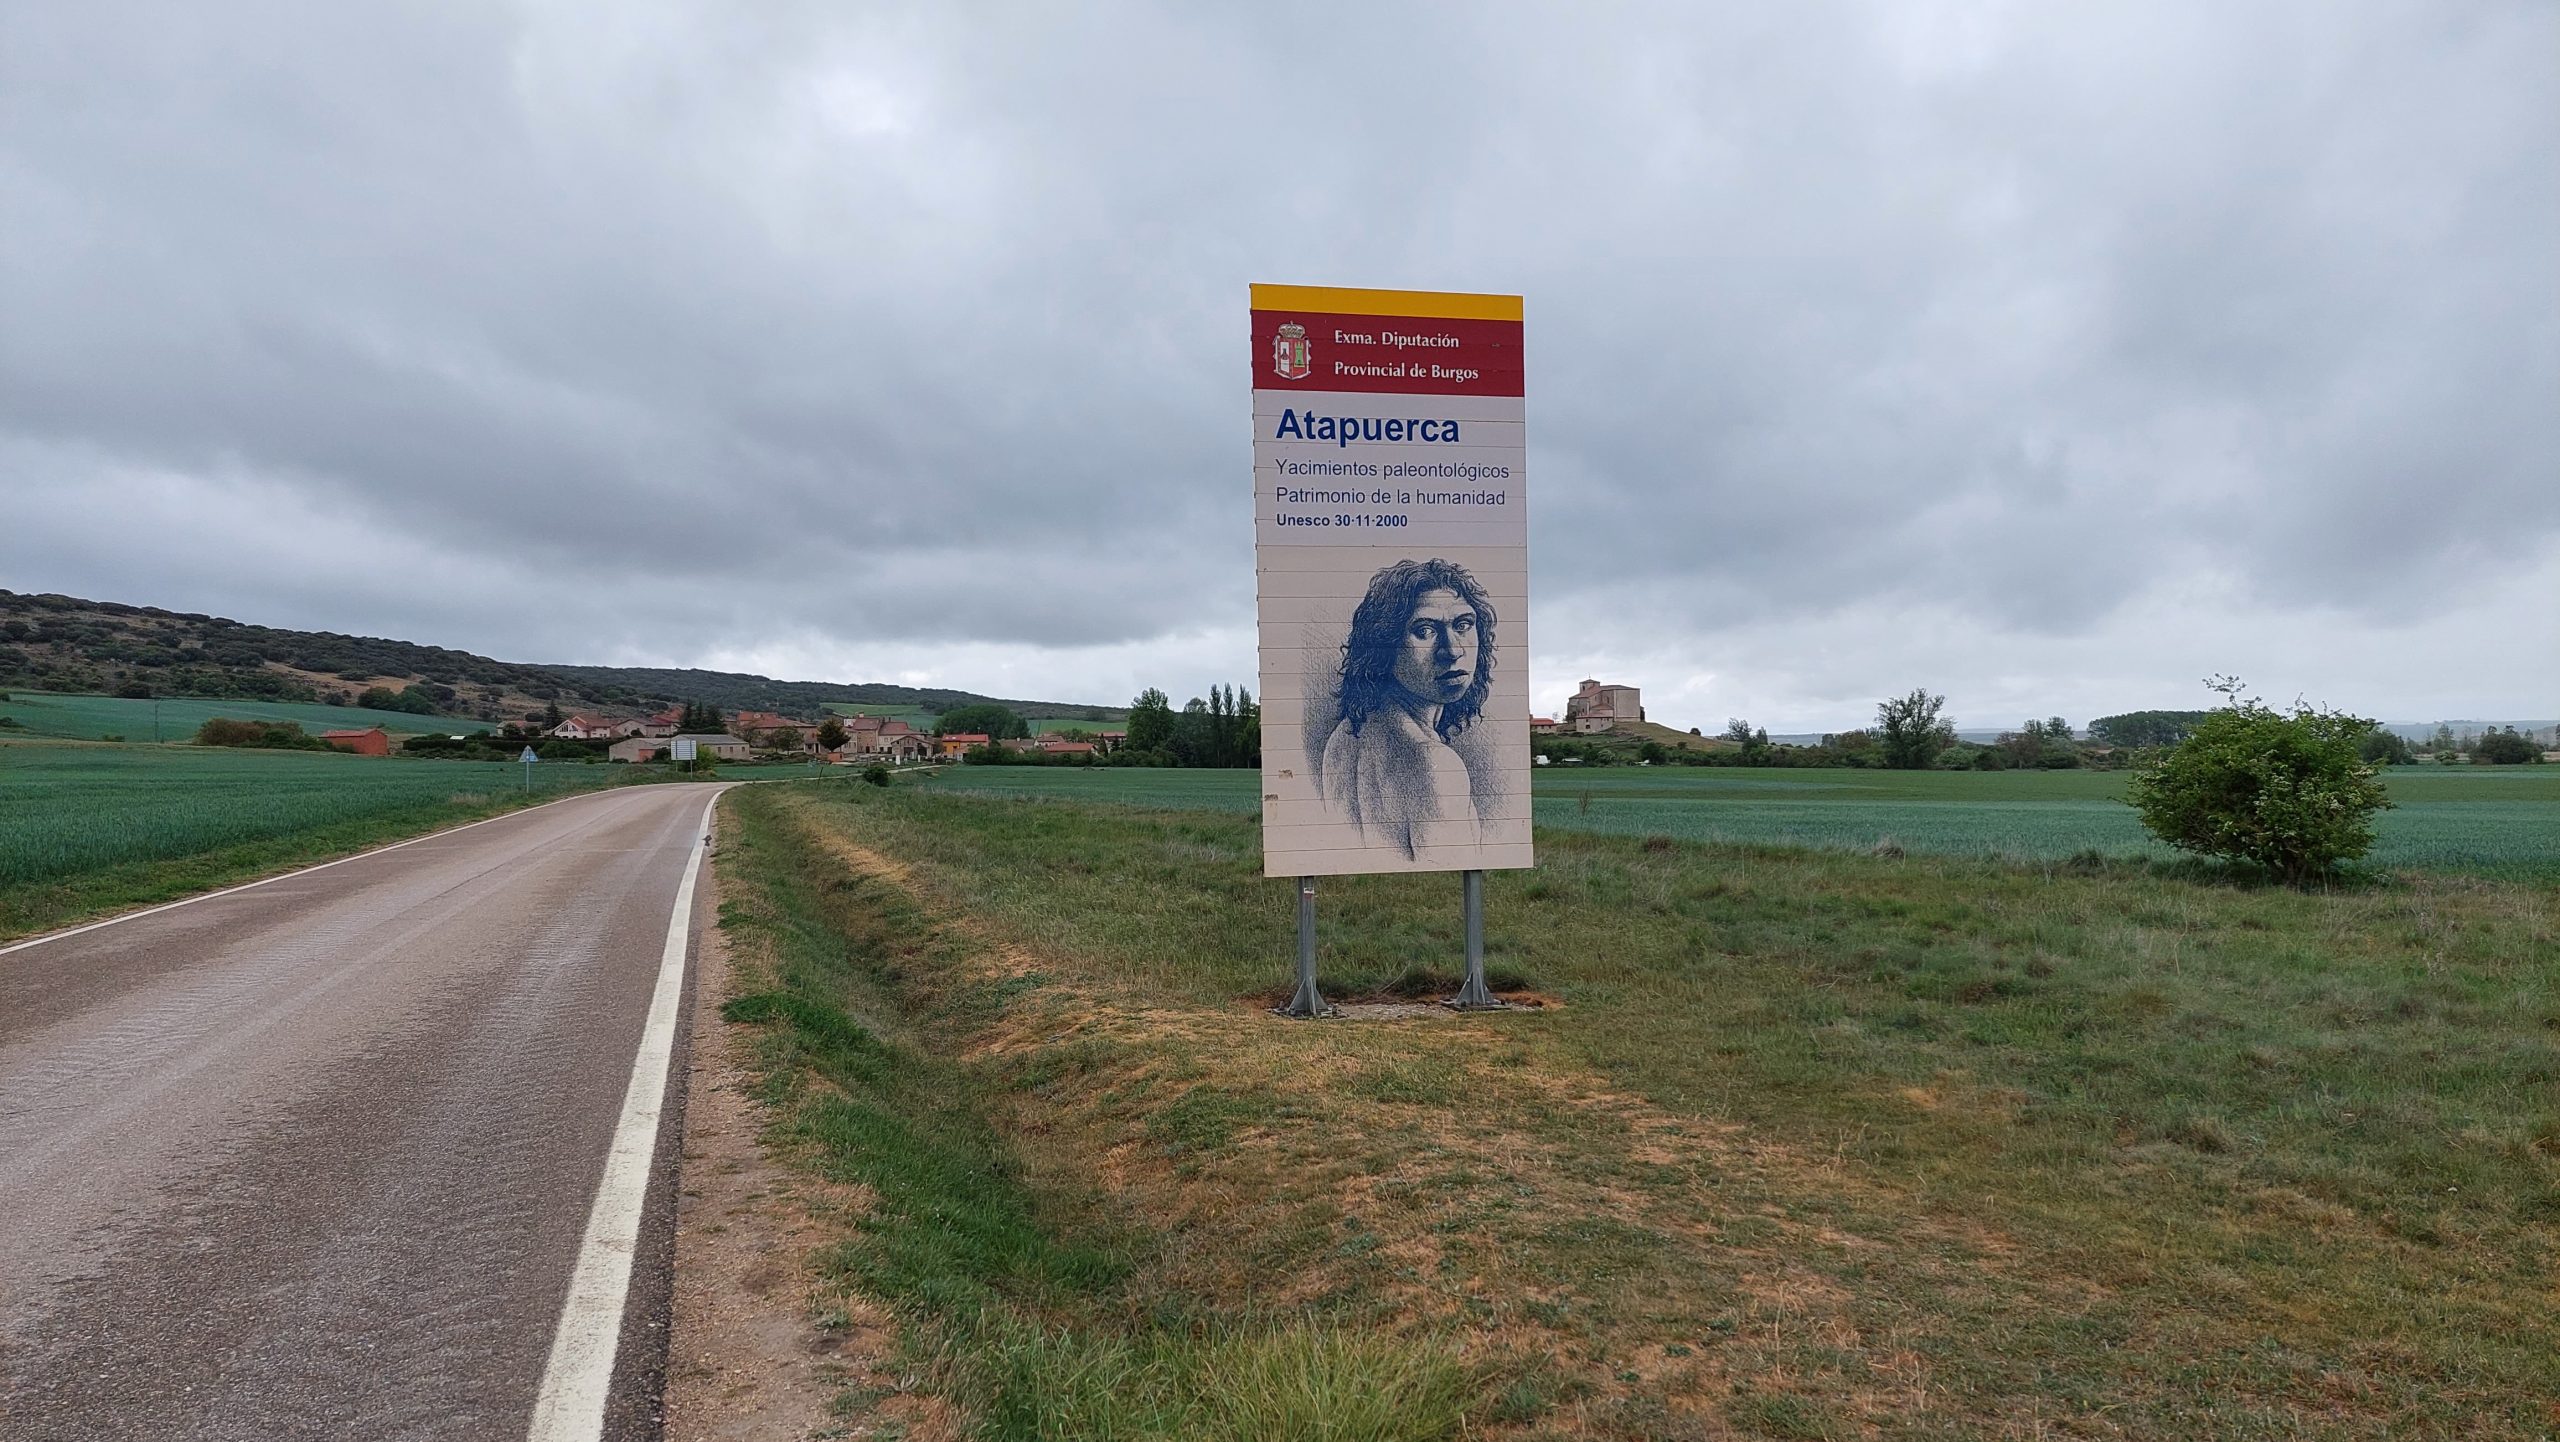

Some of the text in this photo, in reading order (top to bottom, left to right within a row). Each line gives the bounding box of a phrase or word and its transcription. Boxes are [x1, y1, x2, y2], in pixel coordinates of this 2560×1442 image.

[1334, 329, 1460, 350] Exma. Diputación
[1334, 361, 1479, 383] Provincial de Burgos
[1275, 408, 1460, 448] Atapuerca
[1275, 459, 1510, 481] Yacimientos paleontológicos
[1276, 487, 1506, 506] Patrimonio de la humanidad
[1276, 513, 1330, 527] Unesco
